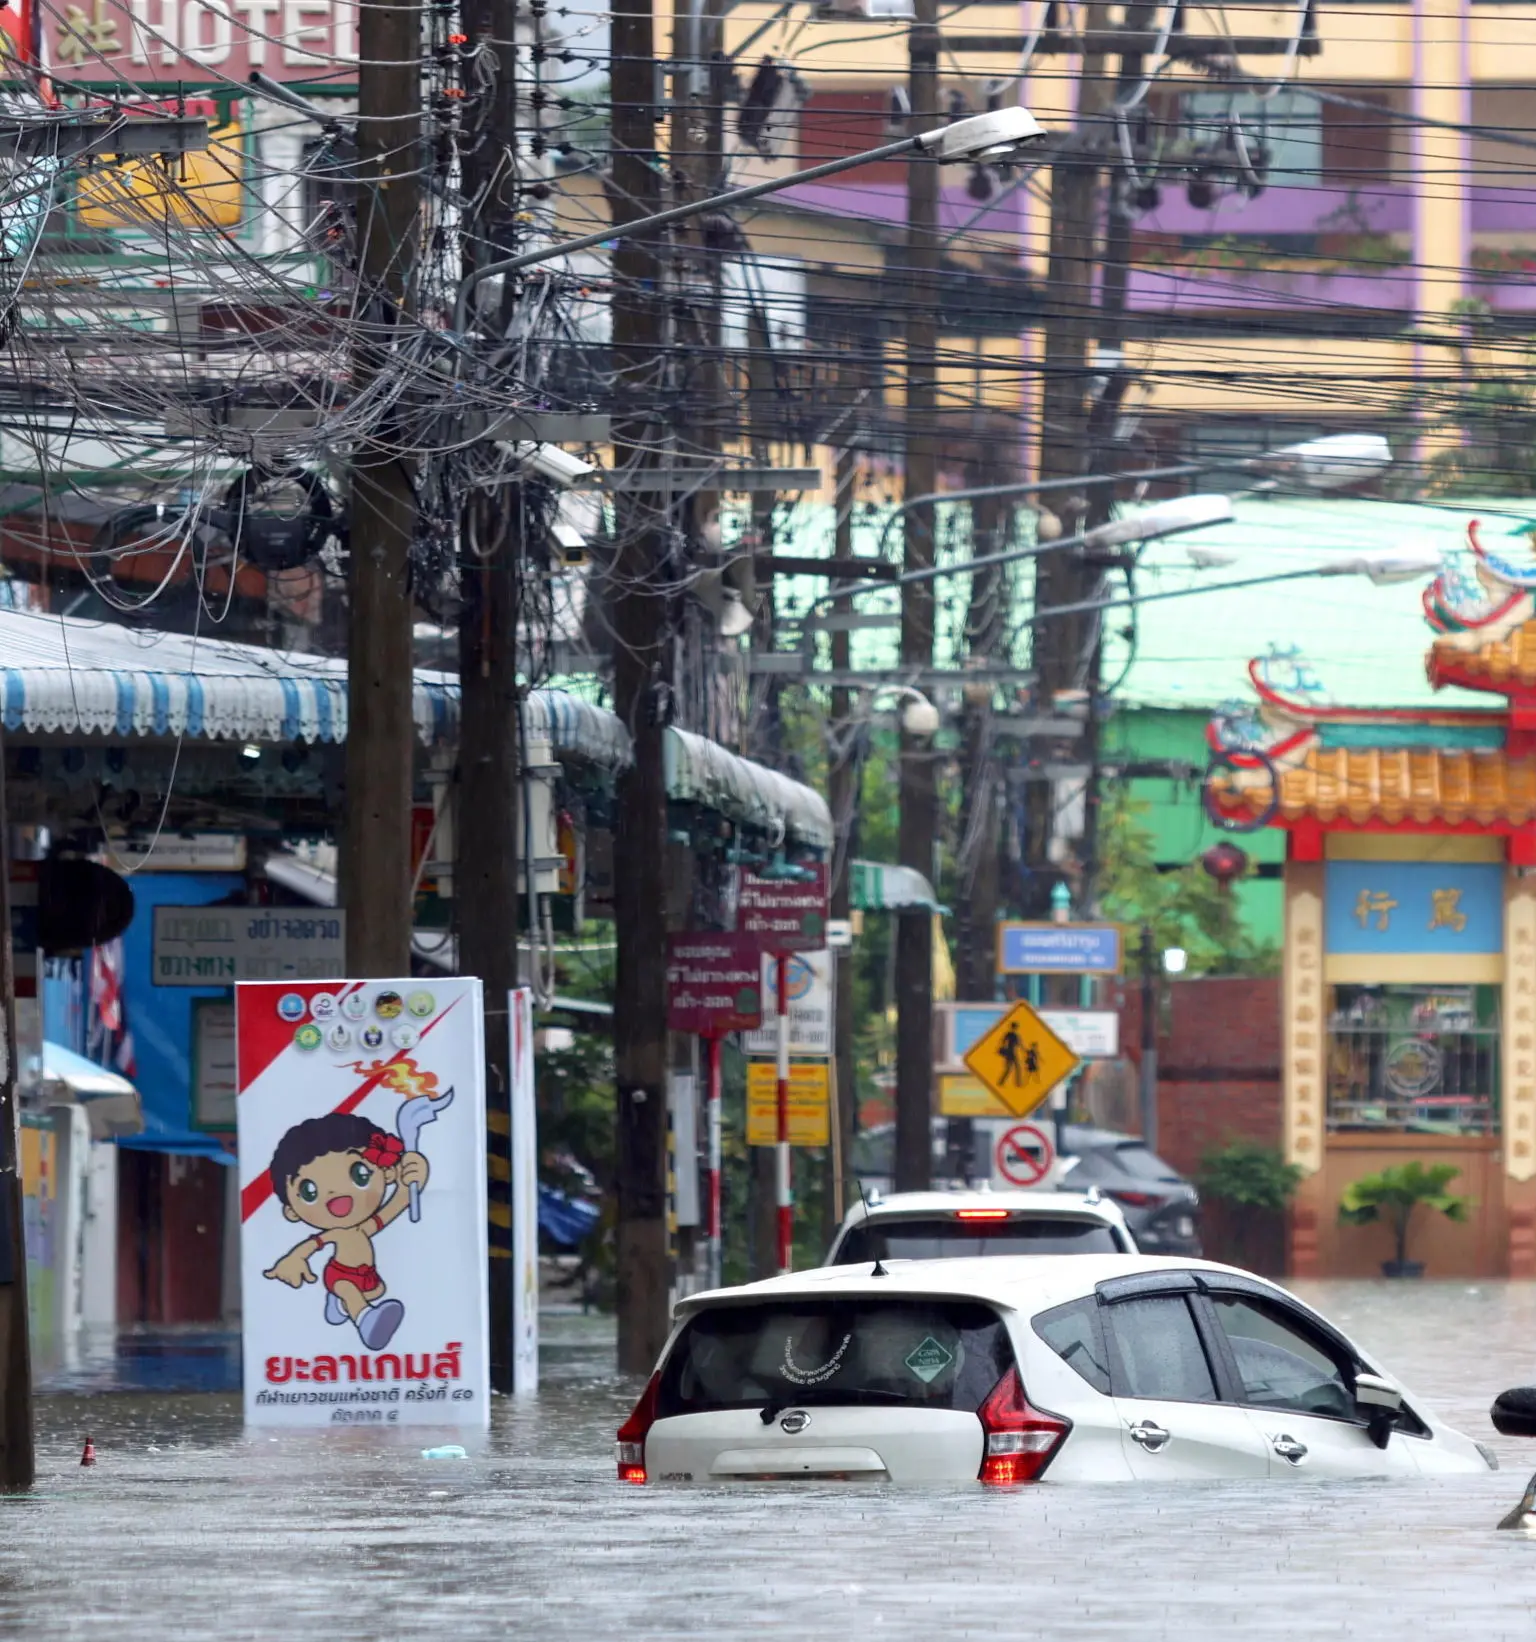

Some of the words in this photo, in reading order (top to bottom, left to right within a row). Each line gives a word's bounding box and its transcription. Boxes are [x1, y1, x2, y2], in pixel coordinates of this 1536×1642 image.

[131, 0, 361, 68] HOTEL
[265, 1342, 463, 1383] ยะลาเกมส์
[255, 1387, 400, 1405] กีฬาเยาวชนแห่งชาติ
[404, 1381, 449, 1401] ครั้งที่
[451, 1388, 474, 1400] ๔๐
